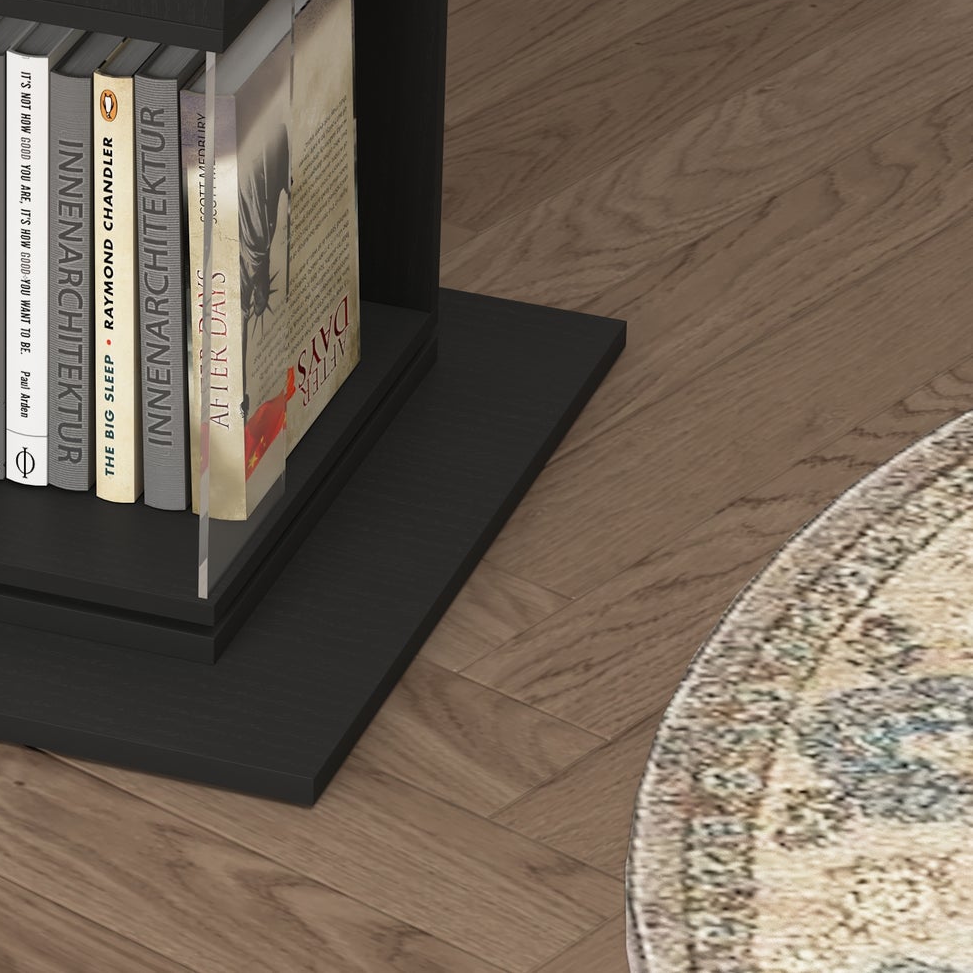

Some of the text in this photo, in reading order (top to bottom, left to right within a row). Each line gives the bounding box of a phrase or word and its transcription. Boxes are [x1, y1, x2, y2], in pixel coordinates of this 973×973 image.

[20, 71, 31, 89] IT'S
[20, 92, 31, 111] NOT
[20, 113, 31, 134] HOW
[20, 136, 31, 161] GOOD
[20, 164, 31, 182] YOU
[20, 184, 31, 204] ARE,
[20, 208, 31, 226] IT'S
[20, 228, 31, 249] HOW
[20, 277, 31, 296] YOU
[140, 106, 172, 446] INNENARCHITEKTUR
[20, 299, 31, 325] WANT
[58, 139, 84, 465] INNENARCHITEKTUR
[103, 137, 115, 476] THE BIG SLEEP RAYMOND CHANDLER
[20, 327, 31, 339] TO
[297, 295, 350, 390] DAYS
[20, 340, 31, 355] BE.
[299, 326, 347, 407] AFTER
[20, 370, 31, 418] Paul Arden
